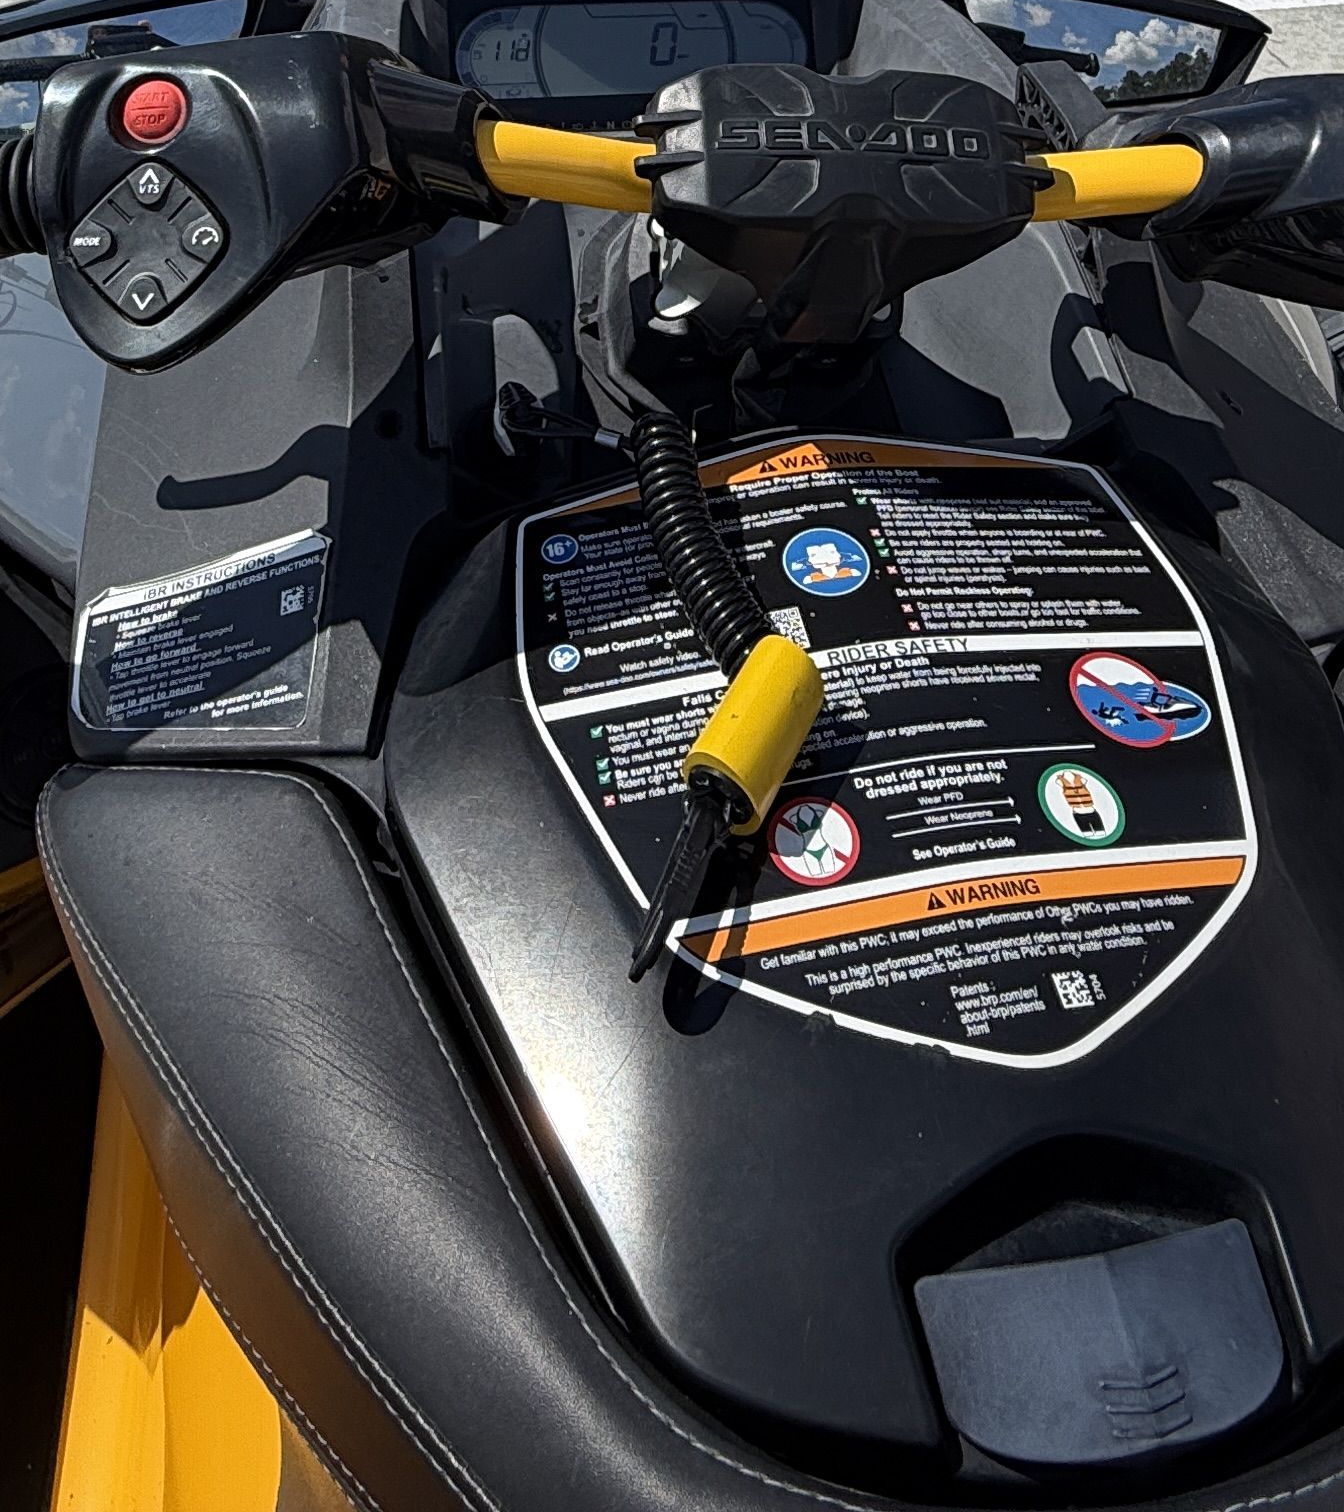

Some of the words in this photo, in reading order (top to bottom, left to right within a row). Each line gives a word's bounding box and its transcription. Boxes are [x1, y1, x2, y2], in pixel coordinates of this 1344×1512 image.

[133, 114, 166, 126] STOP
[139, 184, 160, 194] VTS
[73, 237, 101, 247] MODE
[780, 452, 875, 469] WARNING
[730, 478, 771, 493] Require
[773, 473, 809, 486] Proper
[172, 553, 276, 593] INSTRUCTIONS
[225, 572, 267, 595] REVERSE
[269, 555, 320, 578] FUNCTIONS
[584, 644, 610, 657] Read
[612, 631, 663, 651] Operator's
[665, 627, 694, 641] Guide
[827, 644, 888, 666] RIDER
[895, 638, 969, 655] SAFETY
[620, 661, 647, 673] Watch
[649, 655, 673, 666] safety
[675, 651, 701, 661] video.
[843, 664, 877, 677] Injury
[880, 661, 892, 671] or
[895, 657, 930, 669] Death
[867, 673, 886, 685] keep
[889, 671, 911, 681] water
[913, 668, 933, 678] from
[935, 666, 957, 679] being
[1026, 663, 1041, 672] into
[212, 707, 224, 719] for
[227, 703, 249, 715] more
[252, 690, 304, 709] information.
[217, 689, 261, 709] operator's
[263, 683, 288, 700] guide
[682, 694, 712, 707] Falls
[606, 724, 624, 734] You
[627, 718, 649, 730] must
[652, 714, 673, 725] wear
[676, 707, 705, 720] shorts
[888, 729, 897, 737] or
[899, 723, 944, 737] aggressive
[946, 718, 988, 731] operation.
[608, 730, 638, 743] rectum
[640, 729, 648, 737] or
[651, 722, 680, 736] vagina
[610, 740, 644, 754] vaginal,
[646, 735, 662, 745] and
[665, 729, 697, 741] internal
[612, 756, 630, 766] You
[632, 750, 653, 761] must
[656, 746, 676, 757] wear
[614, 769, 628, 780] Be
[631, 764, 651, 777] sure
[654, 761, 672, 773] you
[617, 778, 646, 790] Riders
[648, 774, 665, 786] can
[667, 771, 678, 780] be
[854, 777, 873, 789] Do
[875, 774, 898, 786] not
[901, 769, 924, 781] ride
[926, 765, 936, 776] if
[939, 765, 962, 778] you
[965, 762, 984, 772] are
[987, 759, 1008, 770] not
[620, 790, 646, 804] Never
[648, 785, 666, 797] ride
[866, 780, 917, 799] dressed
[920, 771, 1005, 791] appropriately.
[918, 796, 941, 807] Wear
[944, 791, 964, 802] PFD
[925, 814, 948, 826] Wear
[951, 809, 994, 823] Neoprene
[912, 849, 933, 861] See
[934, 840, 986, 857] Operator's
[987, 836, 1016, 849] Guide
[947, 878, 1040, 904] WARNING
[761, 957, 780, 970] Get
[782, 951, 816, 966] familiar
[818, 945, 839, 958] with
[840, 940, 858, 953] this
[891, 932, 898, 943] it
[900, 930, 919, 942] may
[922, 920, 958, 936] exceed
[959, 917, 974, 929] the
[976, 910, 1033, 929] performance
[1036, 906, 1046, 919] of
[1103, 900, 1120, 914] you
[1122, 899, 1140, 912] may
[1141, 896, 1164, 908] have
[1165, 894, 1194, 907] ridden.
[806, 973, 828, 987] This
[830, 970, 839, 981] is
[841, 971, 847, 980] a
[849, 964, 870, 980] high
[874, 953, 934, 975] performance
[936, 945, 966, 960] PWC.
[966, 935, 1031, 955] Inexperienced
[1033, 931, 1060, 944] riders
[1062, 929, 1082, 943] may
[1084, 924, 1121, 938] overlook
[1122, 922, 1143, 934] risks
[1145, 921, 1161, 933] and
[1163, 919, 1174, 931] be
[829, 976, 875, 996] surprised
[877, 973, 889, 988] by
[891, 970, 907, 983] the
[910, 962, 946, 982] specific
[947, 955, 988, 972] behavior
[991, 952, 1001, 963] of
[1003, 948, 1020, 960] this
[1021, 943, 1047, 958] PWC
[1048, 941, 1057, 954] in
[1059, 941, 1076, 955] any
[1078, 940, 1102, 952] water
[1105, 935, 1147, 949] condition.
[955, 985, 1038, 1012] www.brp.com/en/
[961, 999, 1046, 1024] about-brp/patents
[966, 1023, 990, 1037] .html
